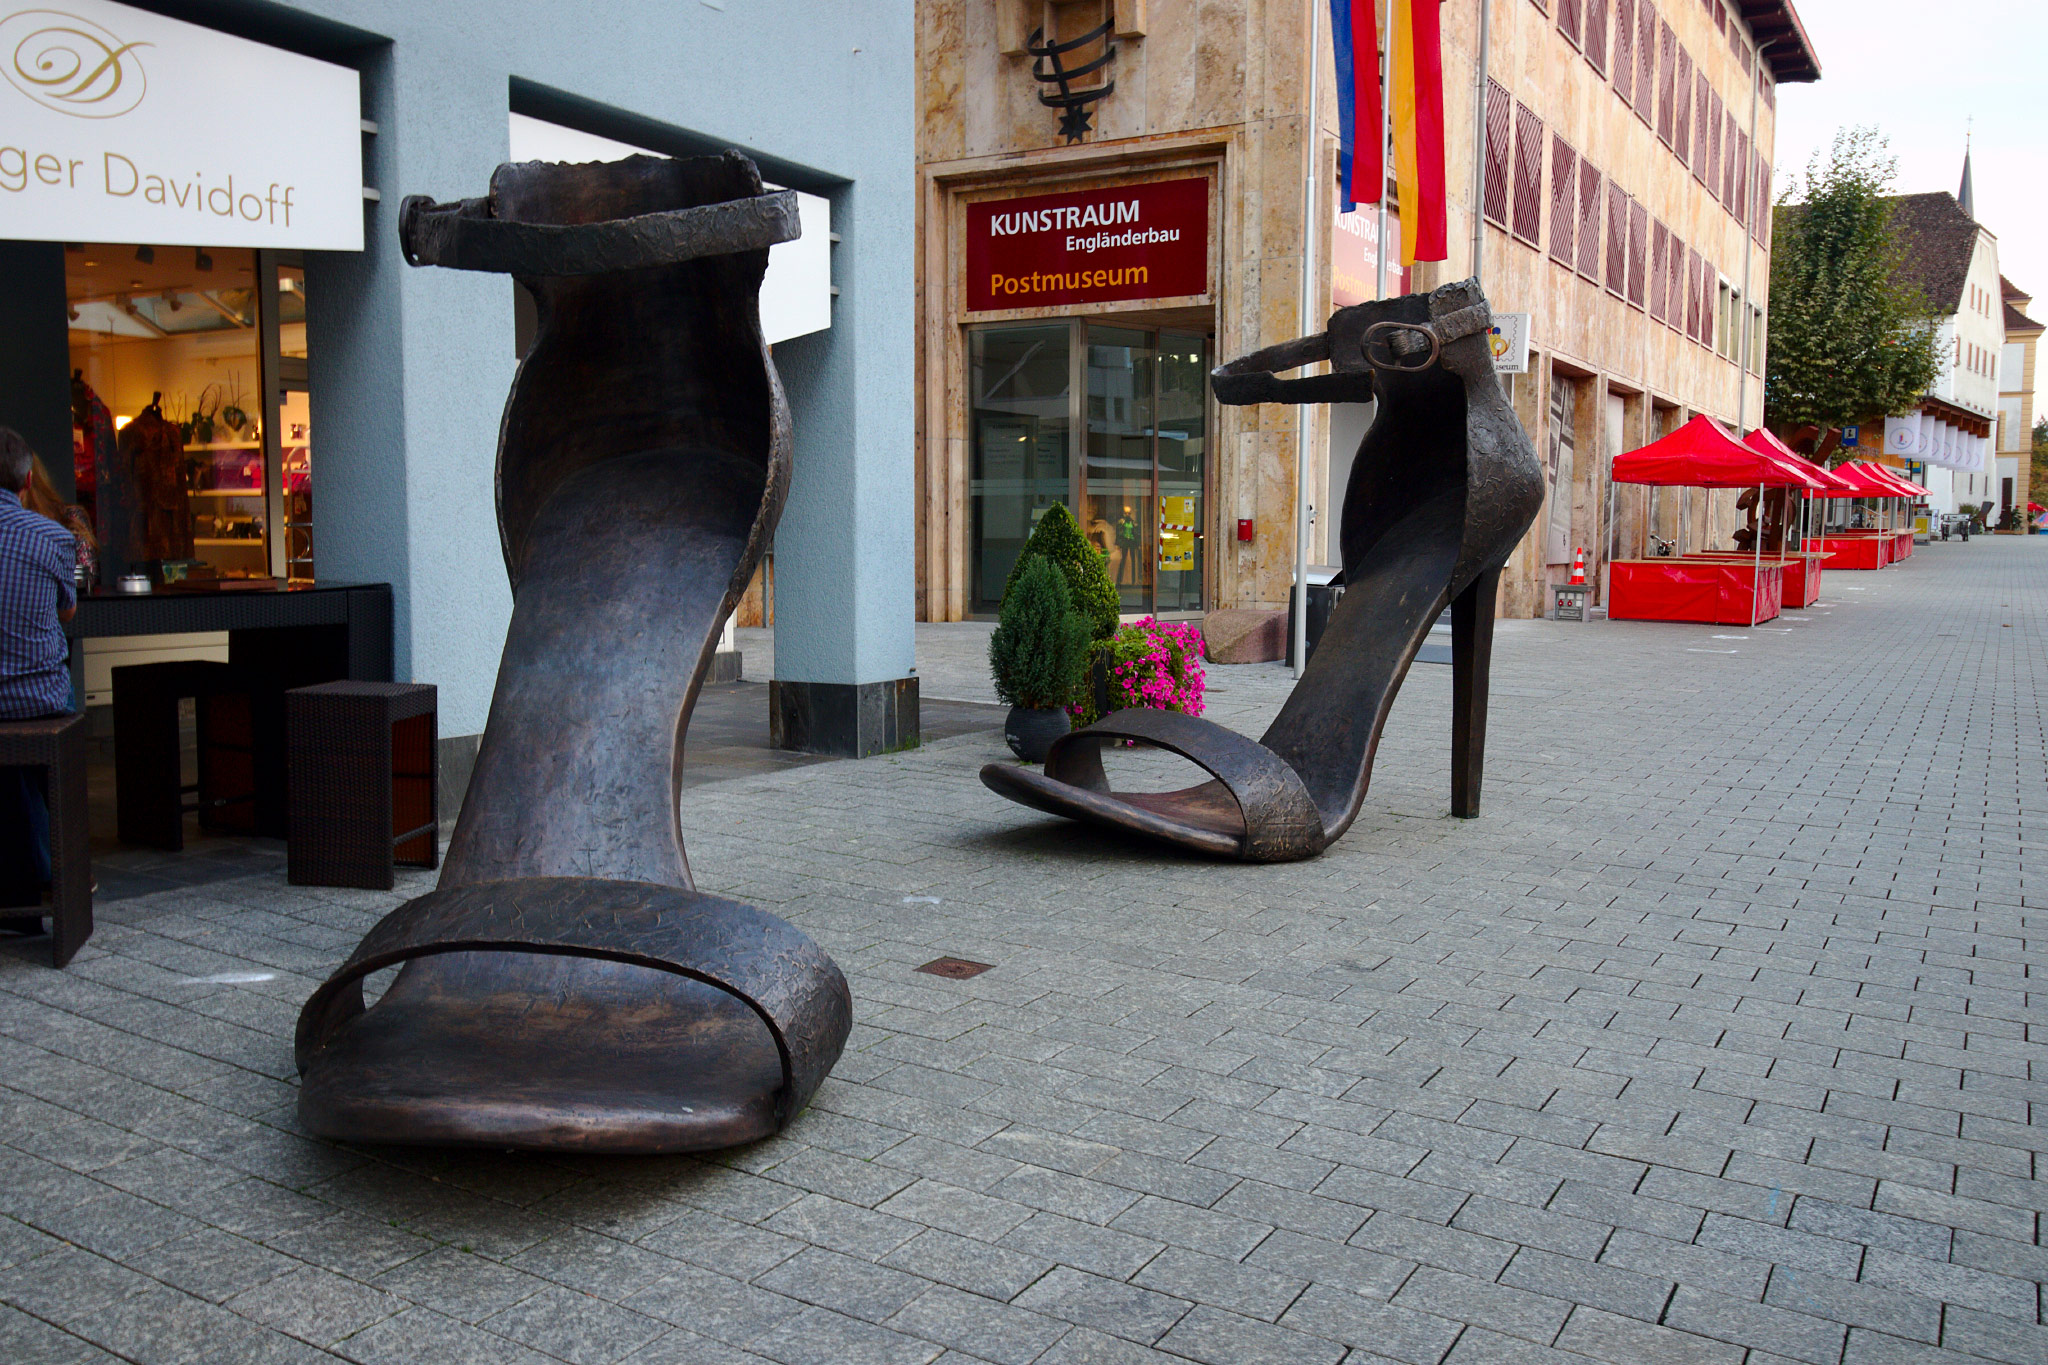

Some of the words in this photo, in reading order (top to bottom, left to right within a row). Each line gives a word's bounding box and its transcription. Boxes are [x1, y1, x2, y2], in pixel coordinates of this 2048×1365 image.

[0, 146, 83, 192] ger
[104, 152, 294, 227] Davidoff
[991, 200, 1139, 236] KUNSTRAUM
[1066, 227, 1180, 253] Engländerbau
[991, 266, 1148, 296] Postmuseum
